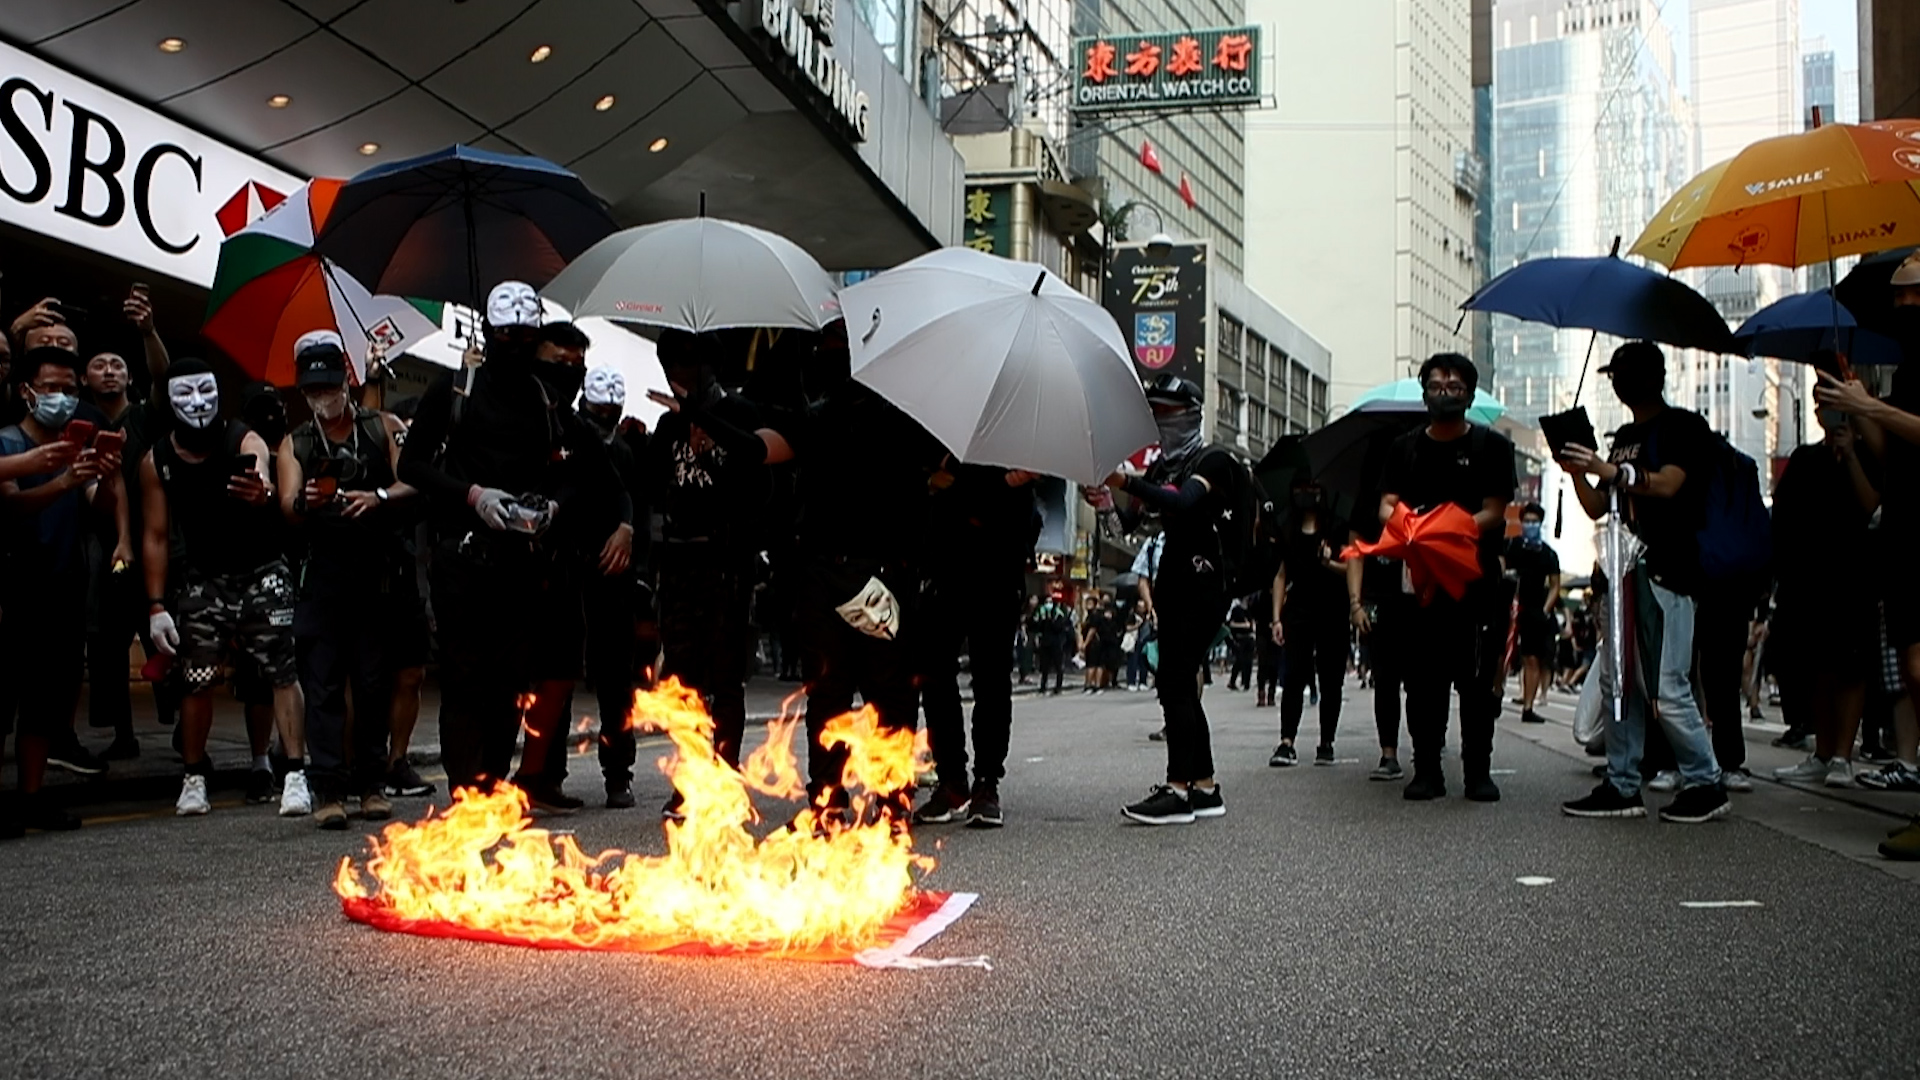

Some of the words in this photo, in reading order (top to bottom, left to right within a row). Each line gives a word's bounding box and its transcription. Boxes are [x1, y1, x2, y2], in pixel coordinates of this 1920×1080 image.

[762, 0, 869, 140] BUILDING
[1080, 83, 1159, 102] ORIENTAL
[1162, 78, 1224, 97] WATCH
[1767, 170, 1823, 190] SMILE
[1131, 274, 1179, 304] 75th
